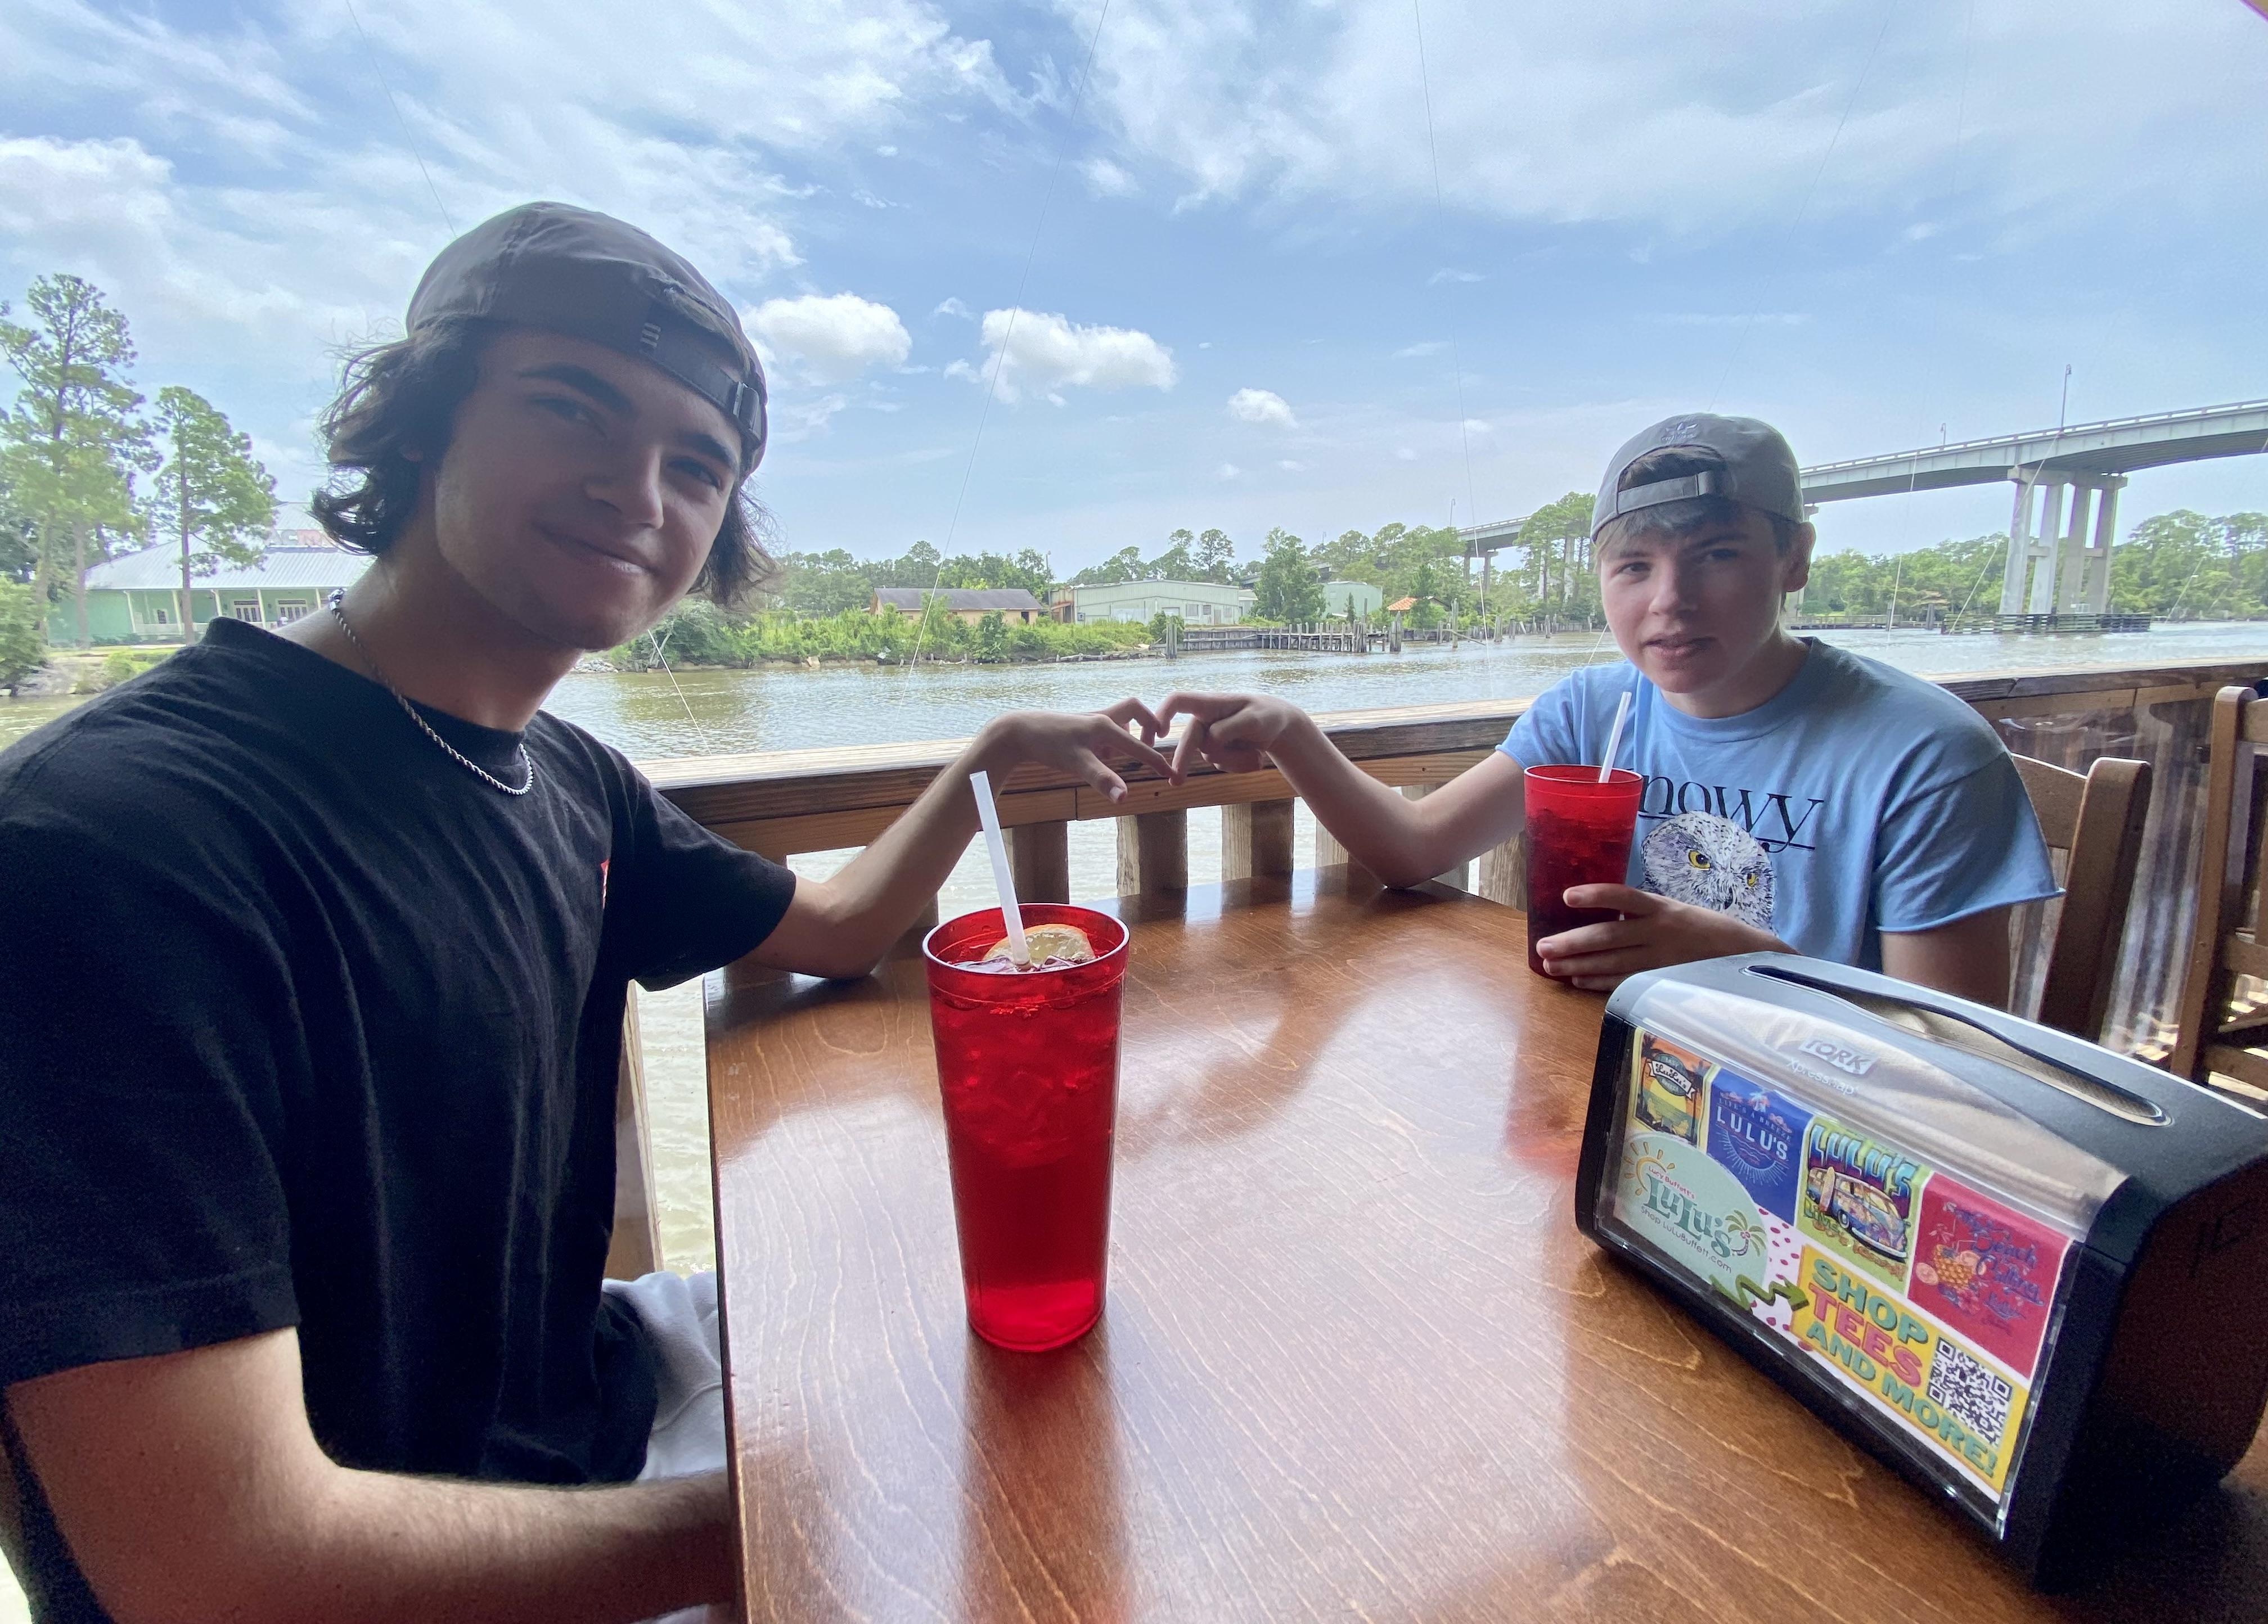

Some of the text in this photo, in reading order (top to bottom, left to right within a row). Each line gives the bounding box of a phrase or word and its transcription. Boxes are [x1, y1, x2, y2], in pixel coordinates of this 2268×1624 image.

[1626, 768, 1824, 853] nowy
[1804, 1039, 1871, 1071] TORK
[1648, 1166, 1664, 1179] Lucy
[1717, 1106, 1788, 1161] LULU'S
[1807, 1124, 1918, 1219] LULU'S
[1808, 1282, 1923, 1388] TEES
[1812, 1258, 1929, 1345] SHOP
[1806, 1320, 1999, 1478] AND MORE!
